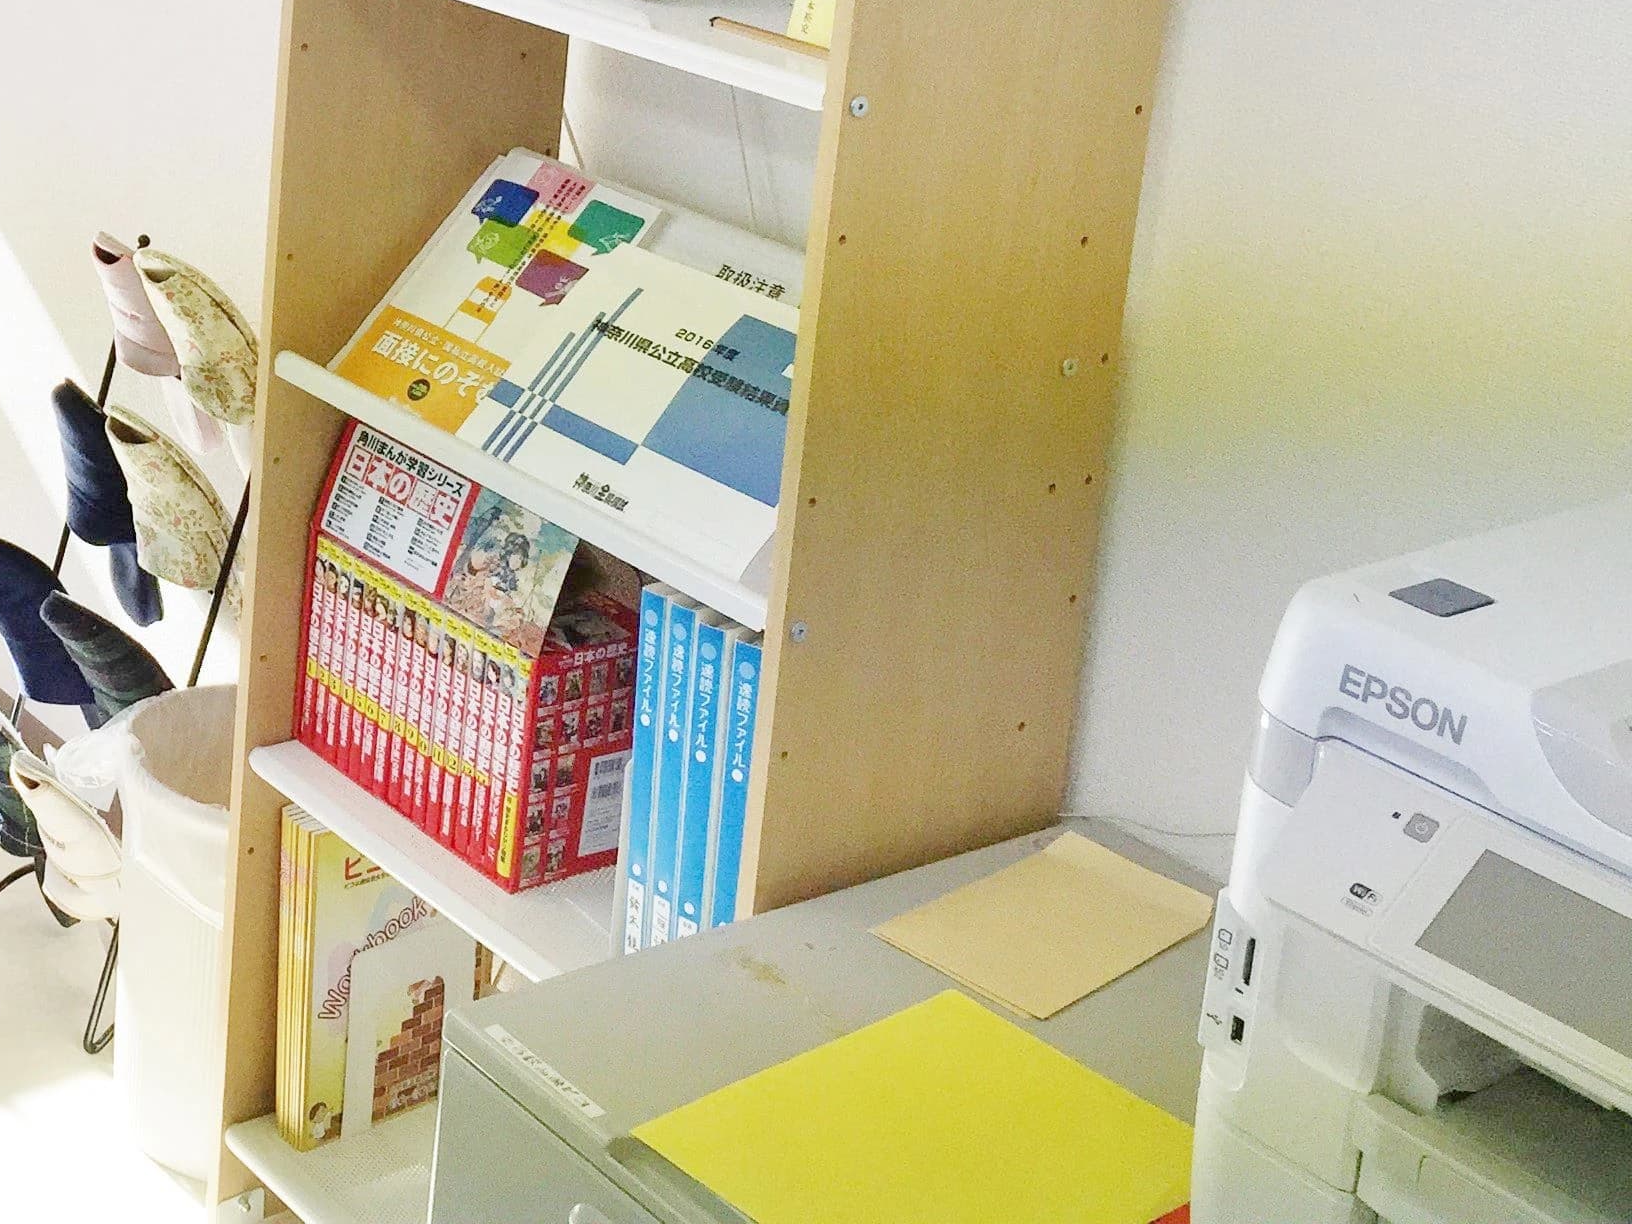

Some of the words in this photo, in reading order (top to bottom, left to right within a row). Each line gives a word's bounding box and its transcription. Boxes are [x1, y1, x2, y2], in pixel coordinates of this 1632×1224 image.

[344, 445, 461, 530] 日本の歴史
[357, 431, 466, 498] 角川まんが学習シリーズ
[1339, 663, 1468, 746] EPSON
[317, 894, 428, 1022] Wobook
